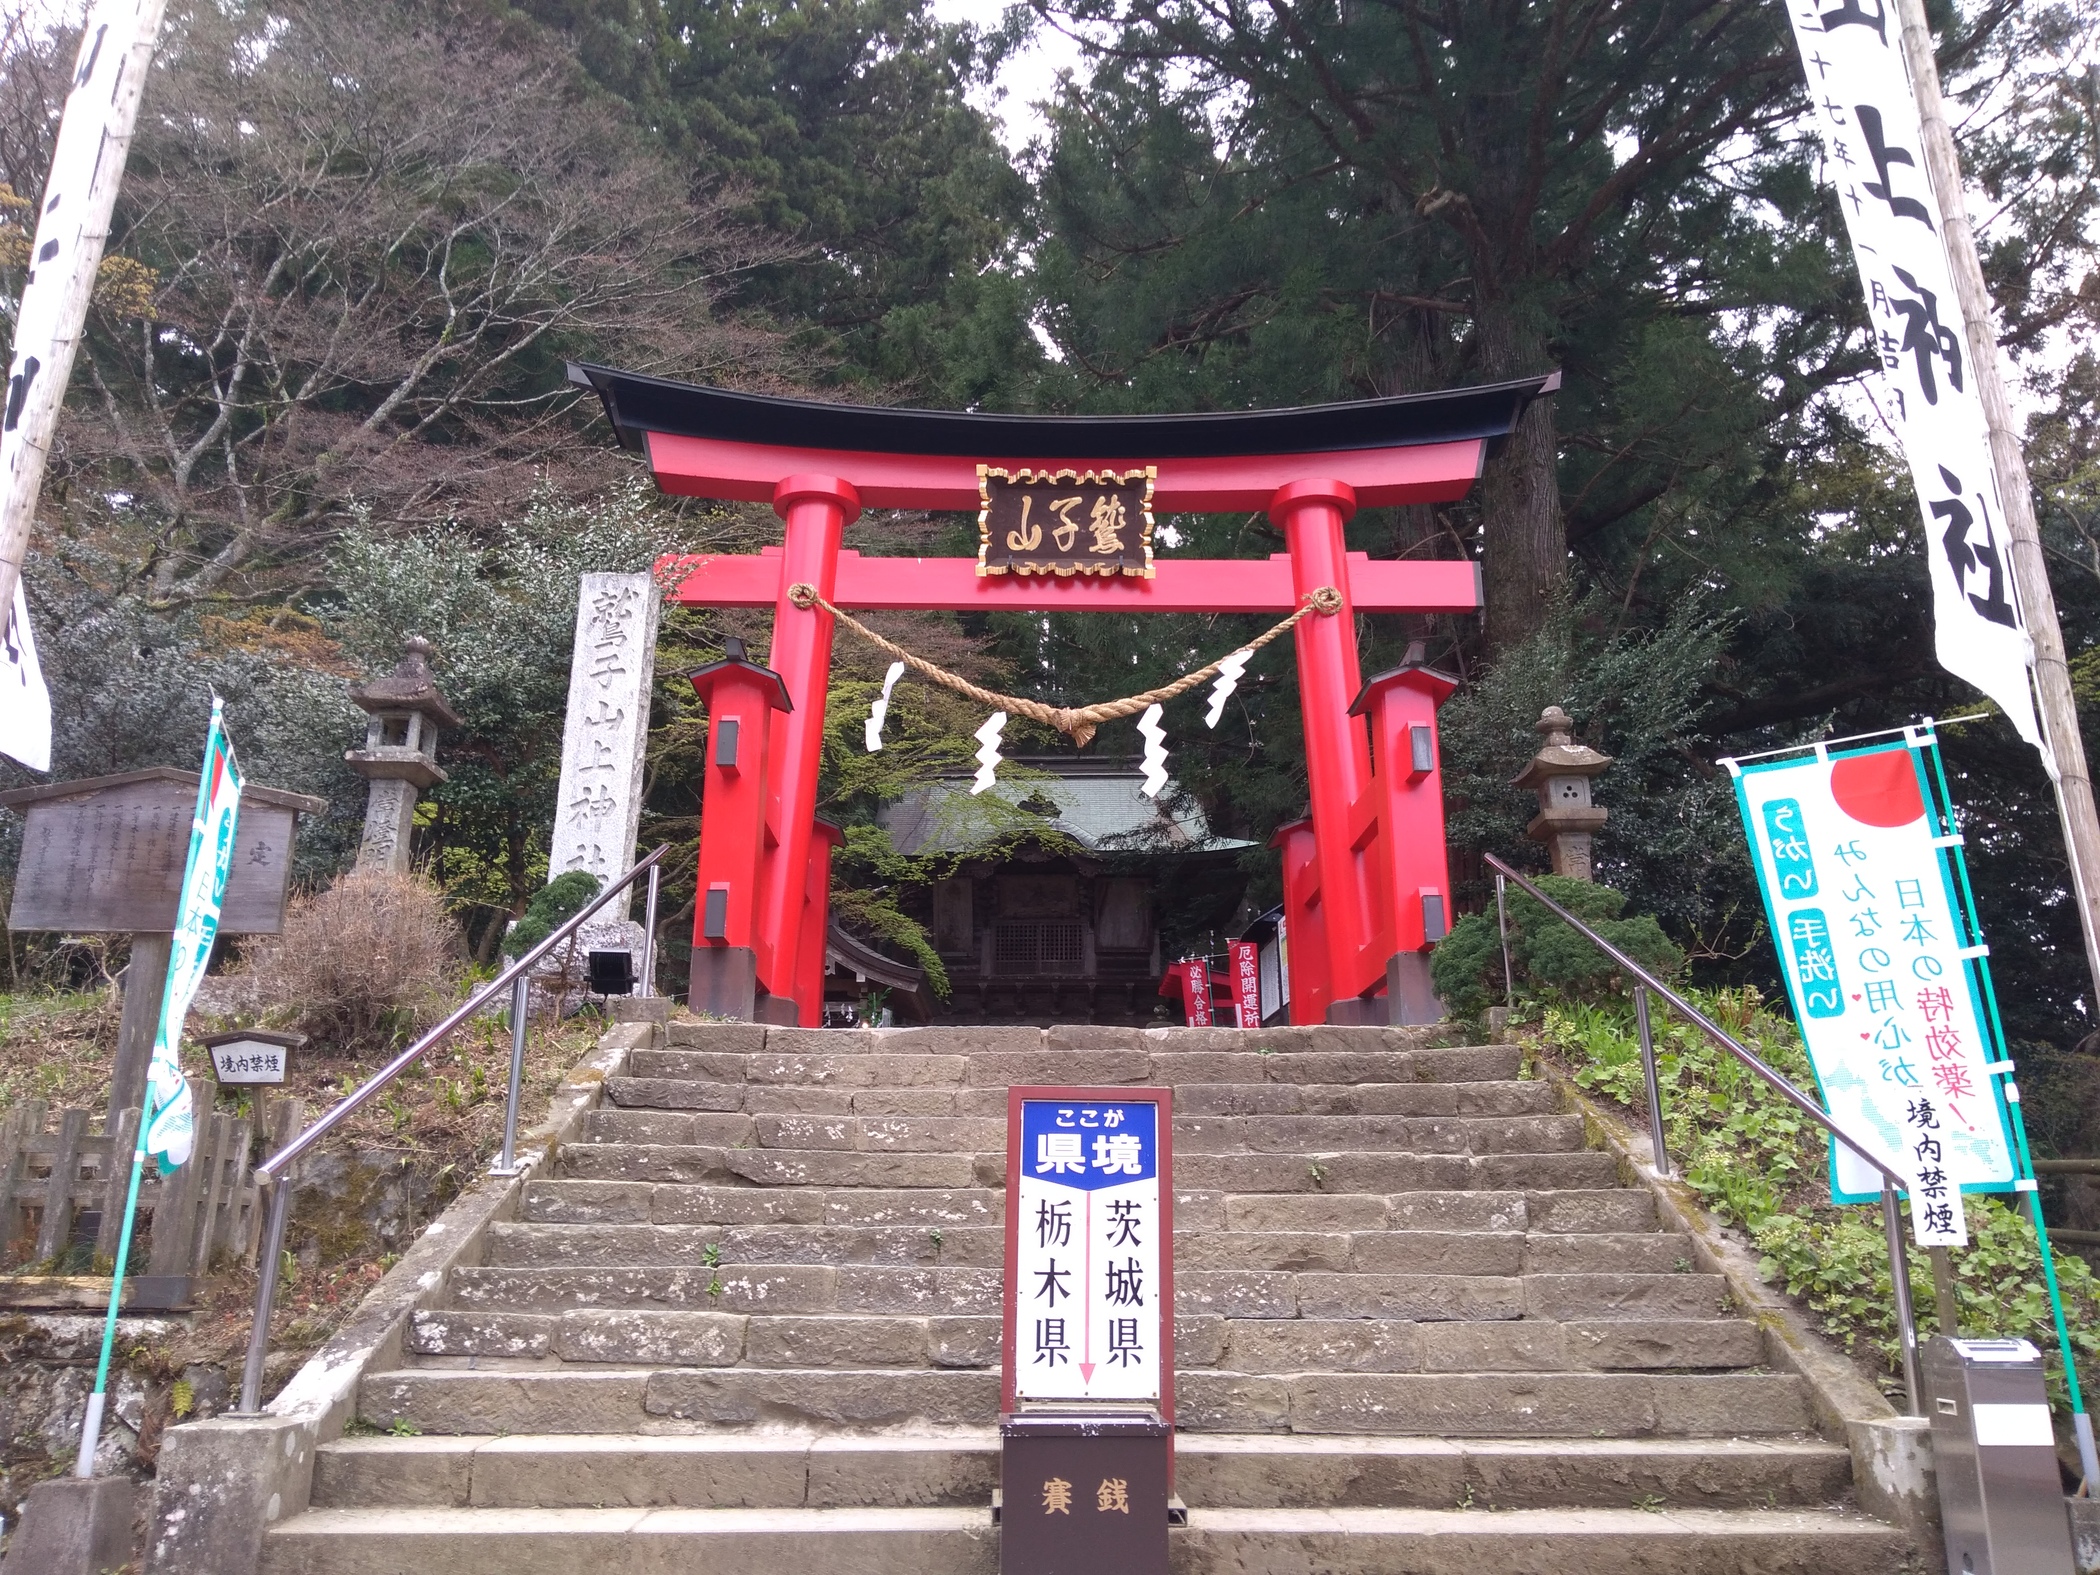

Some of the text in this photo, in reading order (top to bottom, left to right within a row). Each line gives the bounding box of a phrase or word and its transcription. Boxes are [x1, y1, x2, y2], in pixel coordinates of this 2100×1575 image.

[566, 587, 639, 888] 鷲子山上神社
[247, 840, 272, 867] 定
[1189, 965, 1208, 1026] 必勝合格
[1238, 946, 1260, 1028] 厄除開運祈
[220, 1054, 280, 1073] 境内禁煙
[1055, 1109, 1125, 1128] ここが
[1035, 1133, 1143, 1175] 県境
[1906, 1097, 1957, 1234] 境内禁煙
[1032, 1199, 1072, 1368] 栃木県
[1105, 1200, 1144, 1368] 茨城県
[1041, 1477, 1129, 1515] 賽銭
